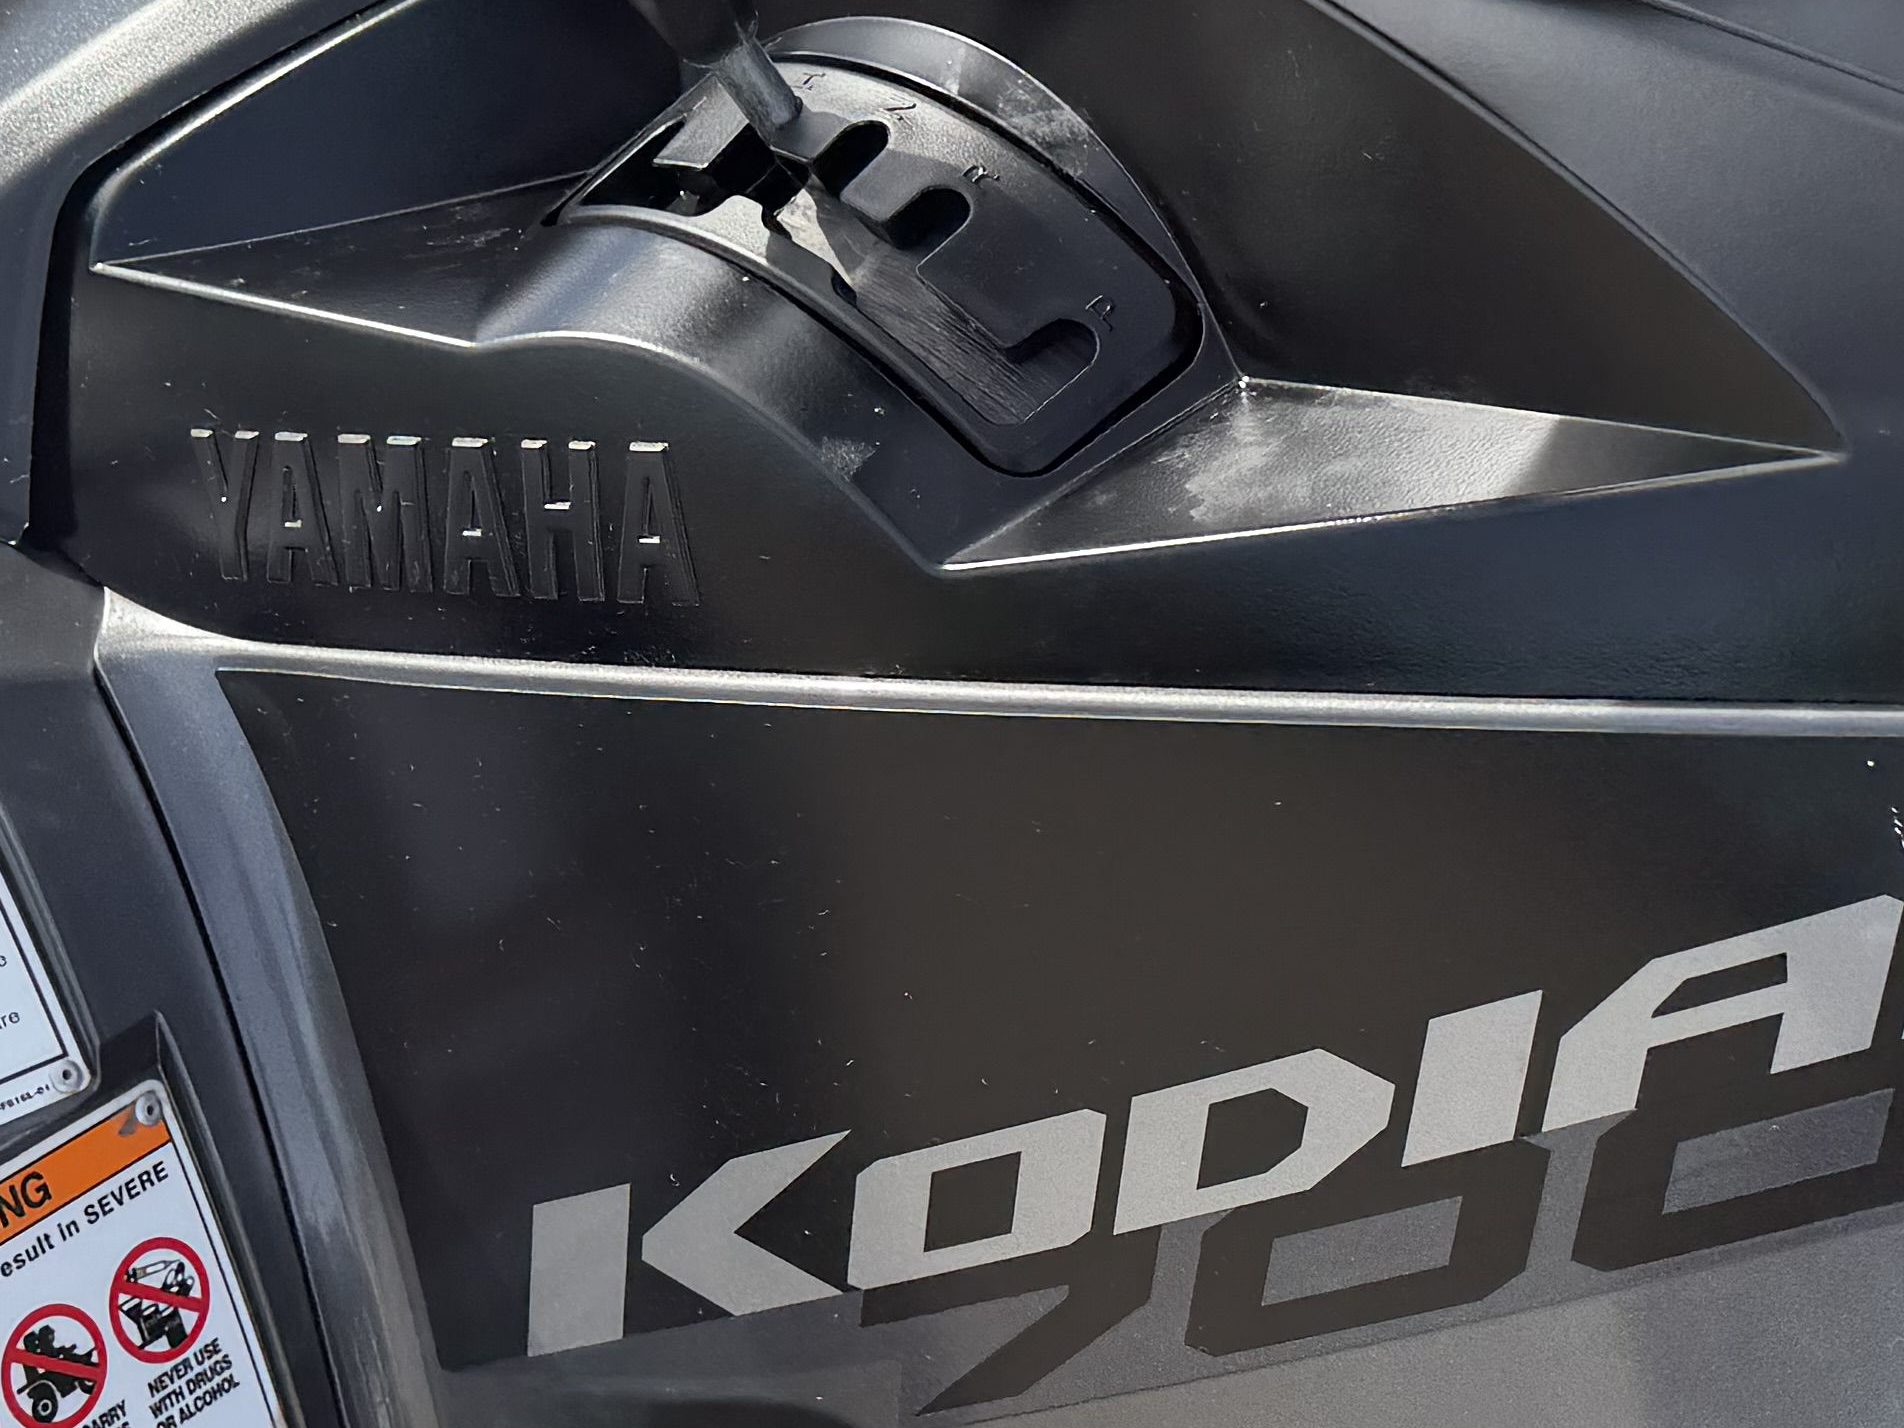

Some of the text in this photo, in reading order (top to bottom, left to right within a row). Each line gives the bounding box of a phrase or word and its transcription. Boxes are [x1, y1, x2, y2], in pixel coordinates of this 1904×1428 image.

[191, 429, 699, 606] YAMAHA
[57, 1220, 80, 1241] in
[84, 1161, 168, 1224] SEVERE
[148, 1337, 222, 1398] NEVER USE
[149, 1354, 232, 1419] WITH DRUGS
[179, 1373, 240, 1424] ALCOHOL
